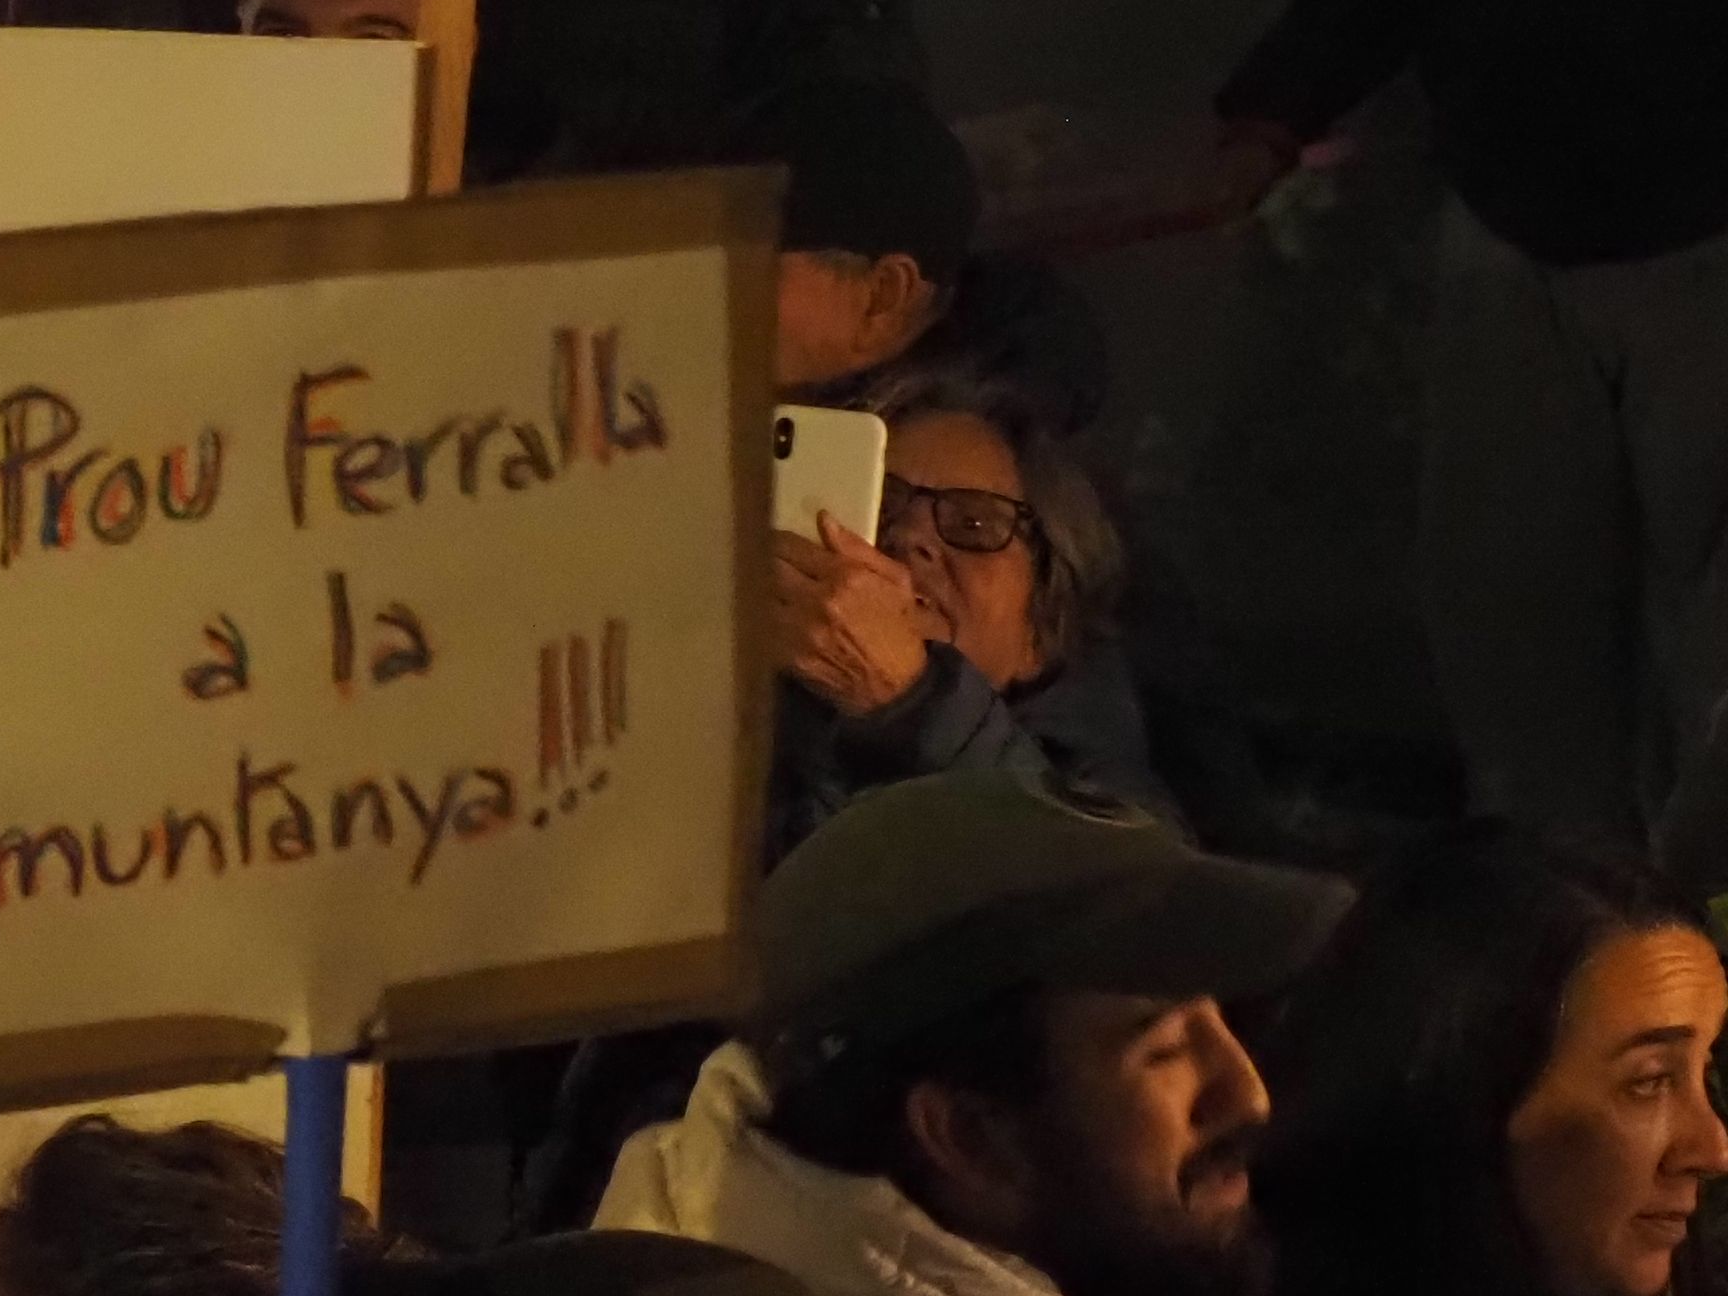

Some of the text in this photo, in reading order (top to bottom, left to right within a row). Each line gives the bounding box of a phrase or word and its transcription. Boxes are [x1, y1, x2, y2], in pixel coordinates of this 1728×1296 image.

[284, 325, 671, 530] Ferralla
[180, 571, 435, 702] a la
